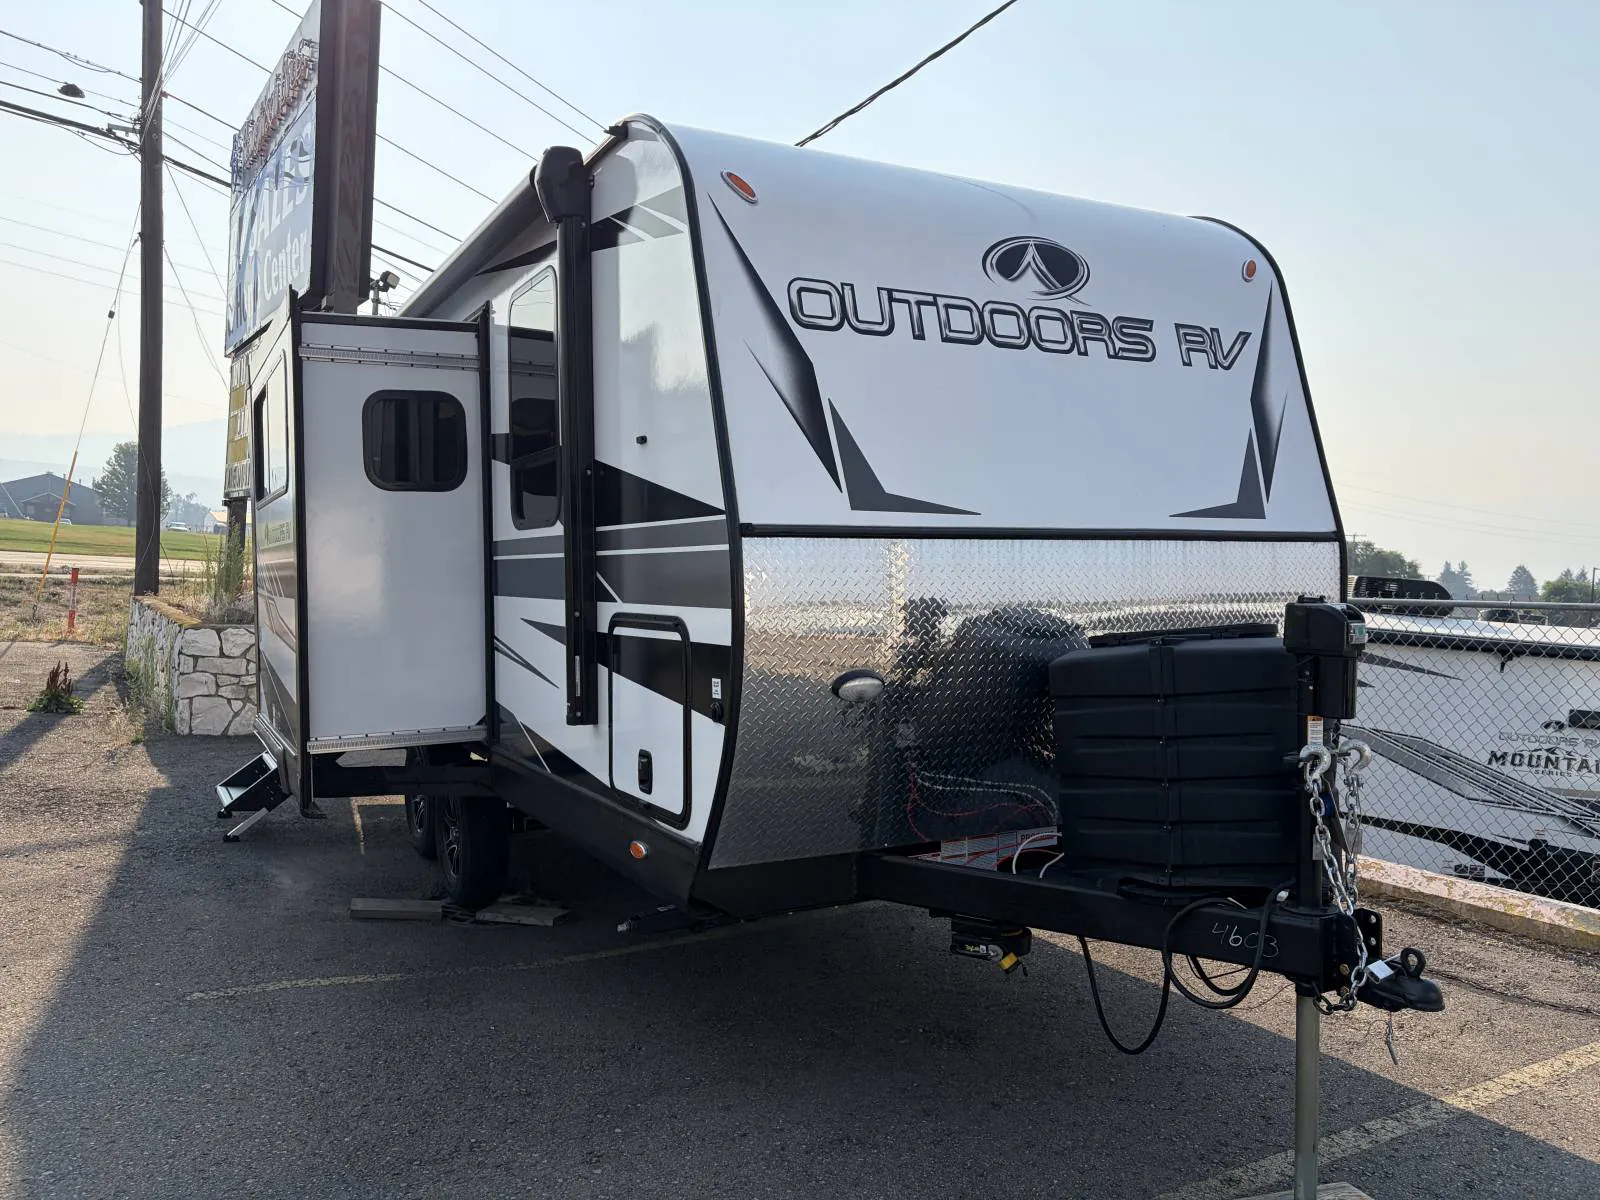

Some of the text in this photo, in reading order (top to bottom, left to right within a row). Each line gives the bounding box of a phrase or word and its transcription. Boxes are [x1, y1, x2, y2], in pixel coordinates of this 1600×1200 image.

[263, 227, 307, 301] Center
[787, 277, 1253, 371] OUTDOORS RV
[1534, 769, 1572, 778] SERIES
